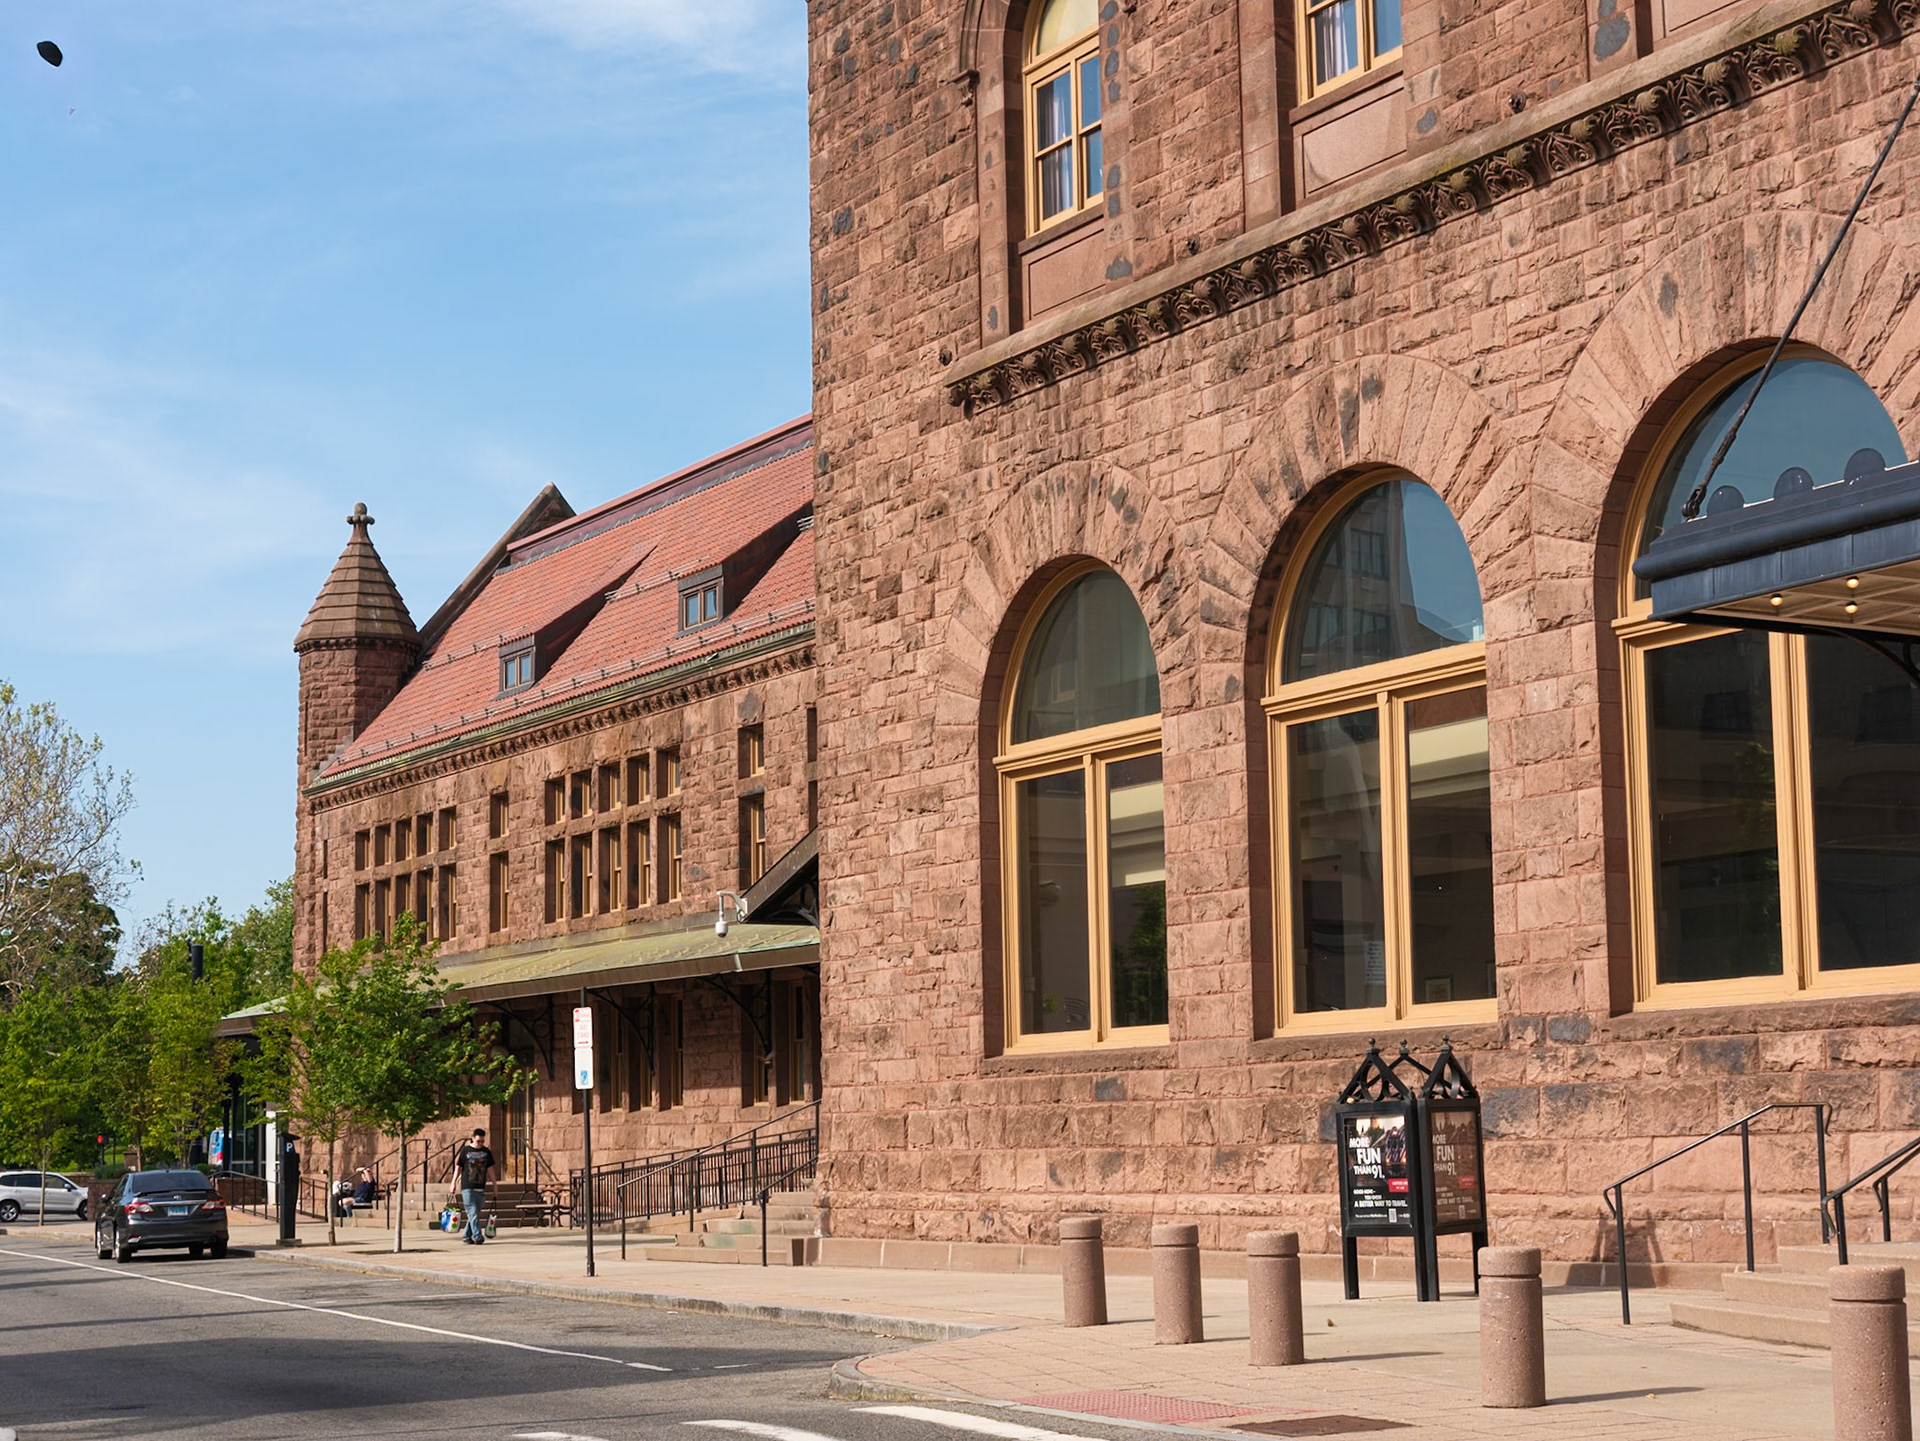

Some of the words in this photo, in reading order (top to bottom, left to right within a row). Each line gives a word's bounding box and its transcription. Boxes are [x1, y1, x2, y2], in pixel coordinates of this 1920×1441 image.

[286, 1142, 293, 1152] P
[1349, 1138, 1370, 1148] MORE
[1356, 1148, 1381, 1164] FUN
[1436, 1145, 1454, 1161] FUN
[1354, 1166, 1372, 1175] THAN
